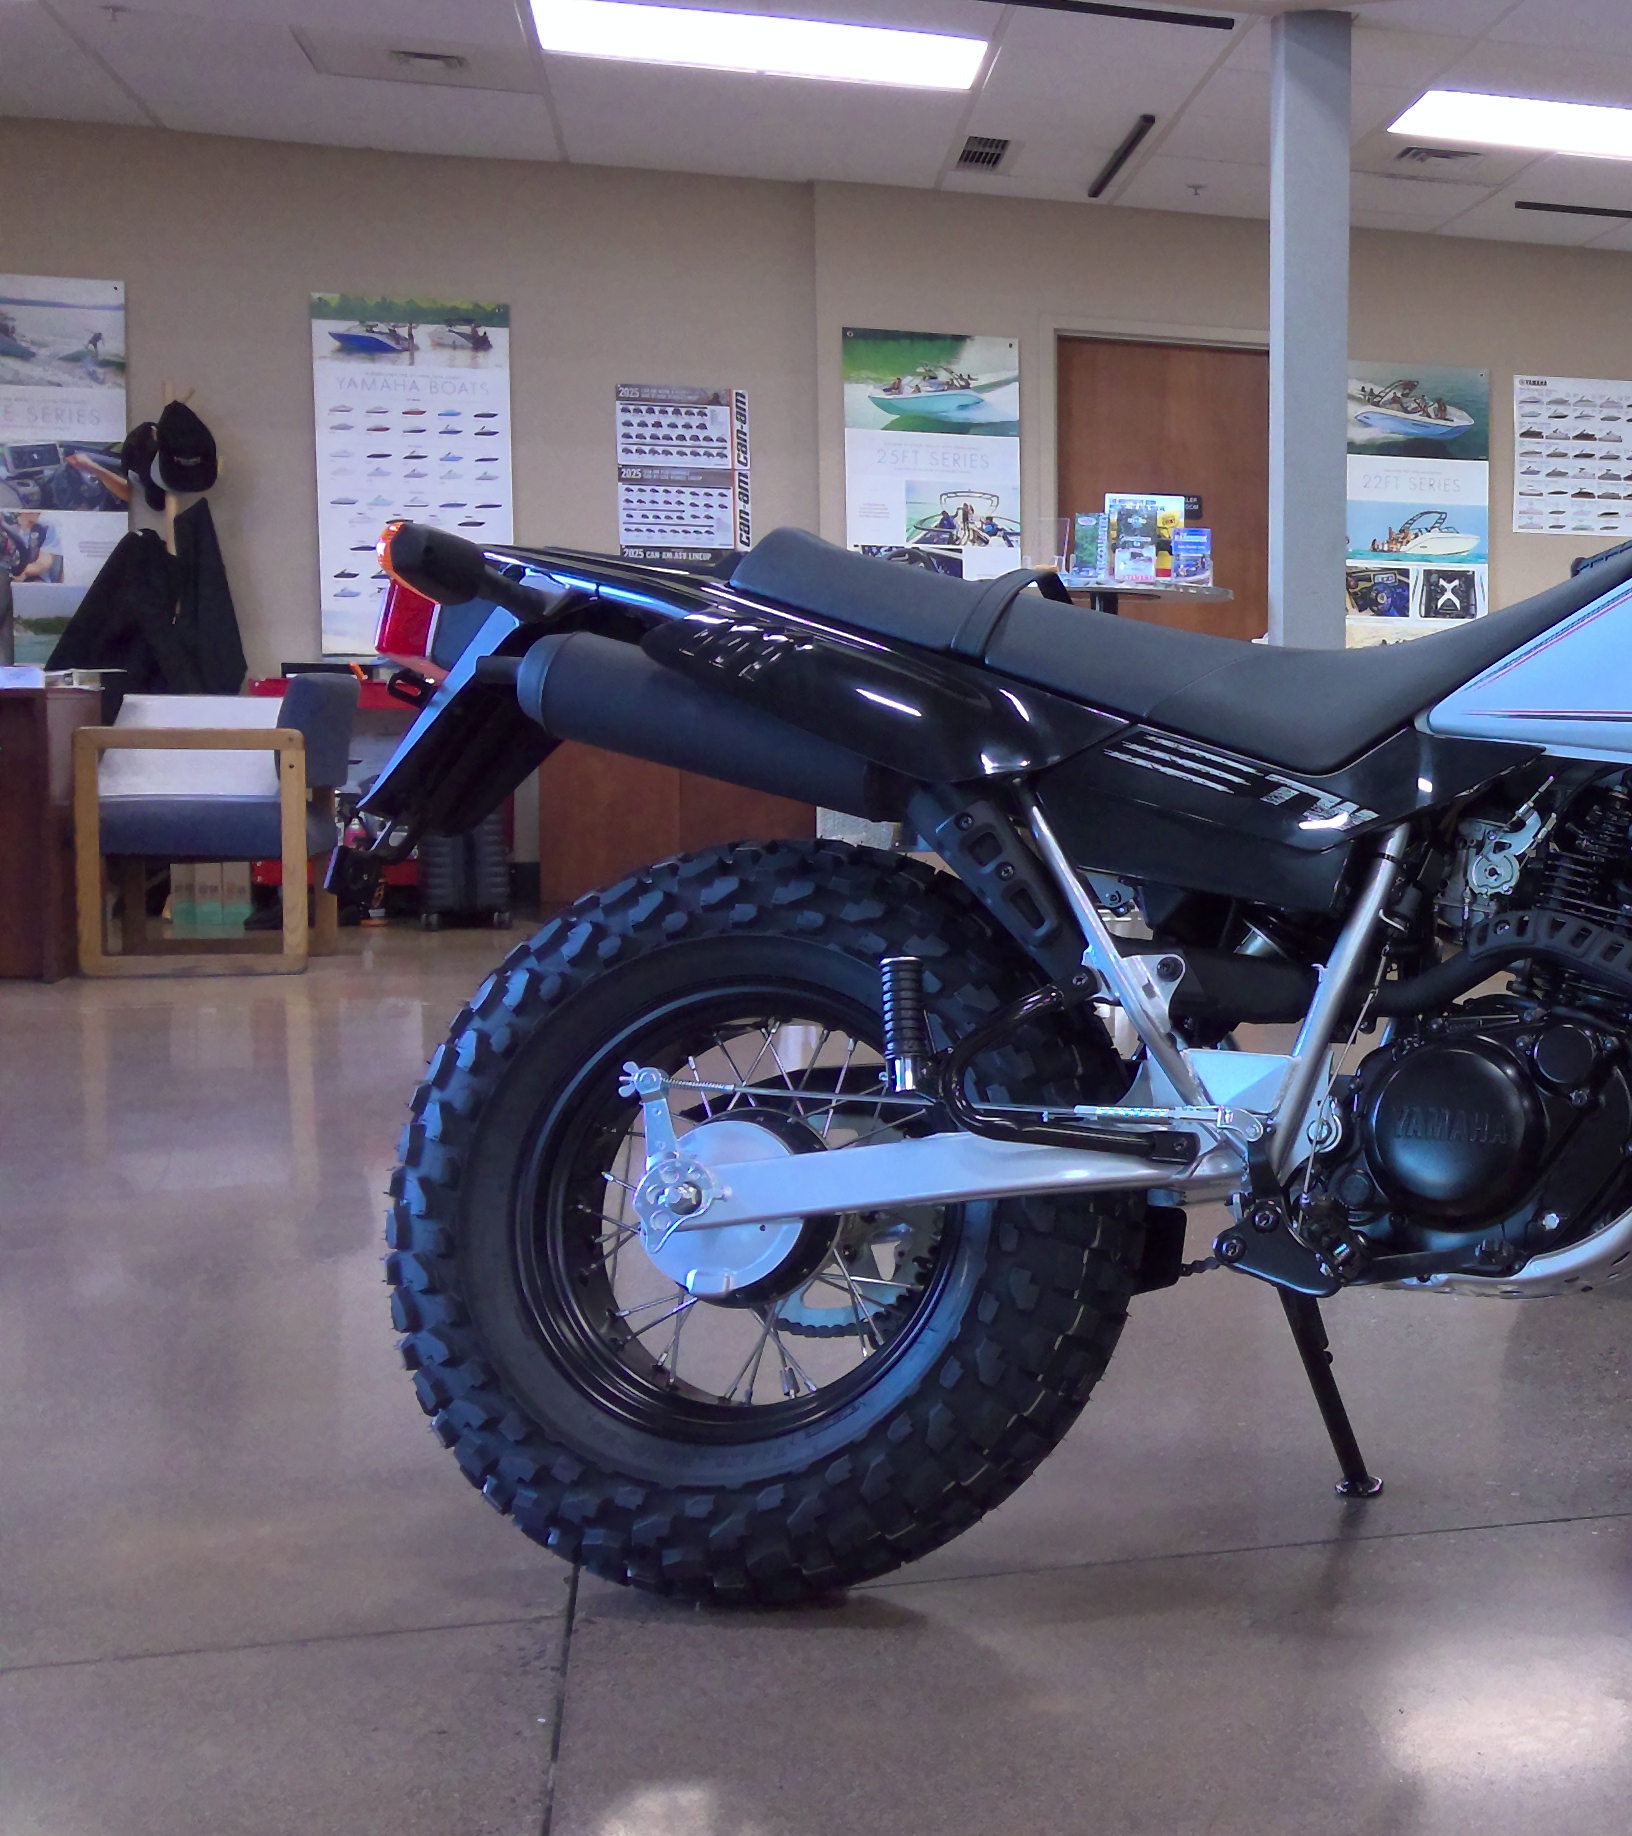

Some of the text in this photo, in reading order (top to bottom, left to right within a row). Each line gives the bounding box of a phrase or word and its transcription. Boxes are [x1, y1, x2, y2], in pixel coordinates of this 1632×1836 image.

[337, 377, 490, 396] YAMAHA BOATS
[618, 387, 640, 397] 2025
[1524, 379, 1548, 387] YAMAHA
[26, 405, 101, 426] SERIES
[735, 391, 748, 468] can-am
[877, 449, 990, 469] 25FT SERIES
[621, 468, 642, 479] 2025
[1362, 474, 1461, 493] 22FT SERIES
[737, 472, 751, 548] can-am
[623, 548, 645, 559] 2025
[1394, 1105, 1509, 1145] YAMAHA
